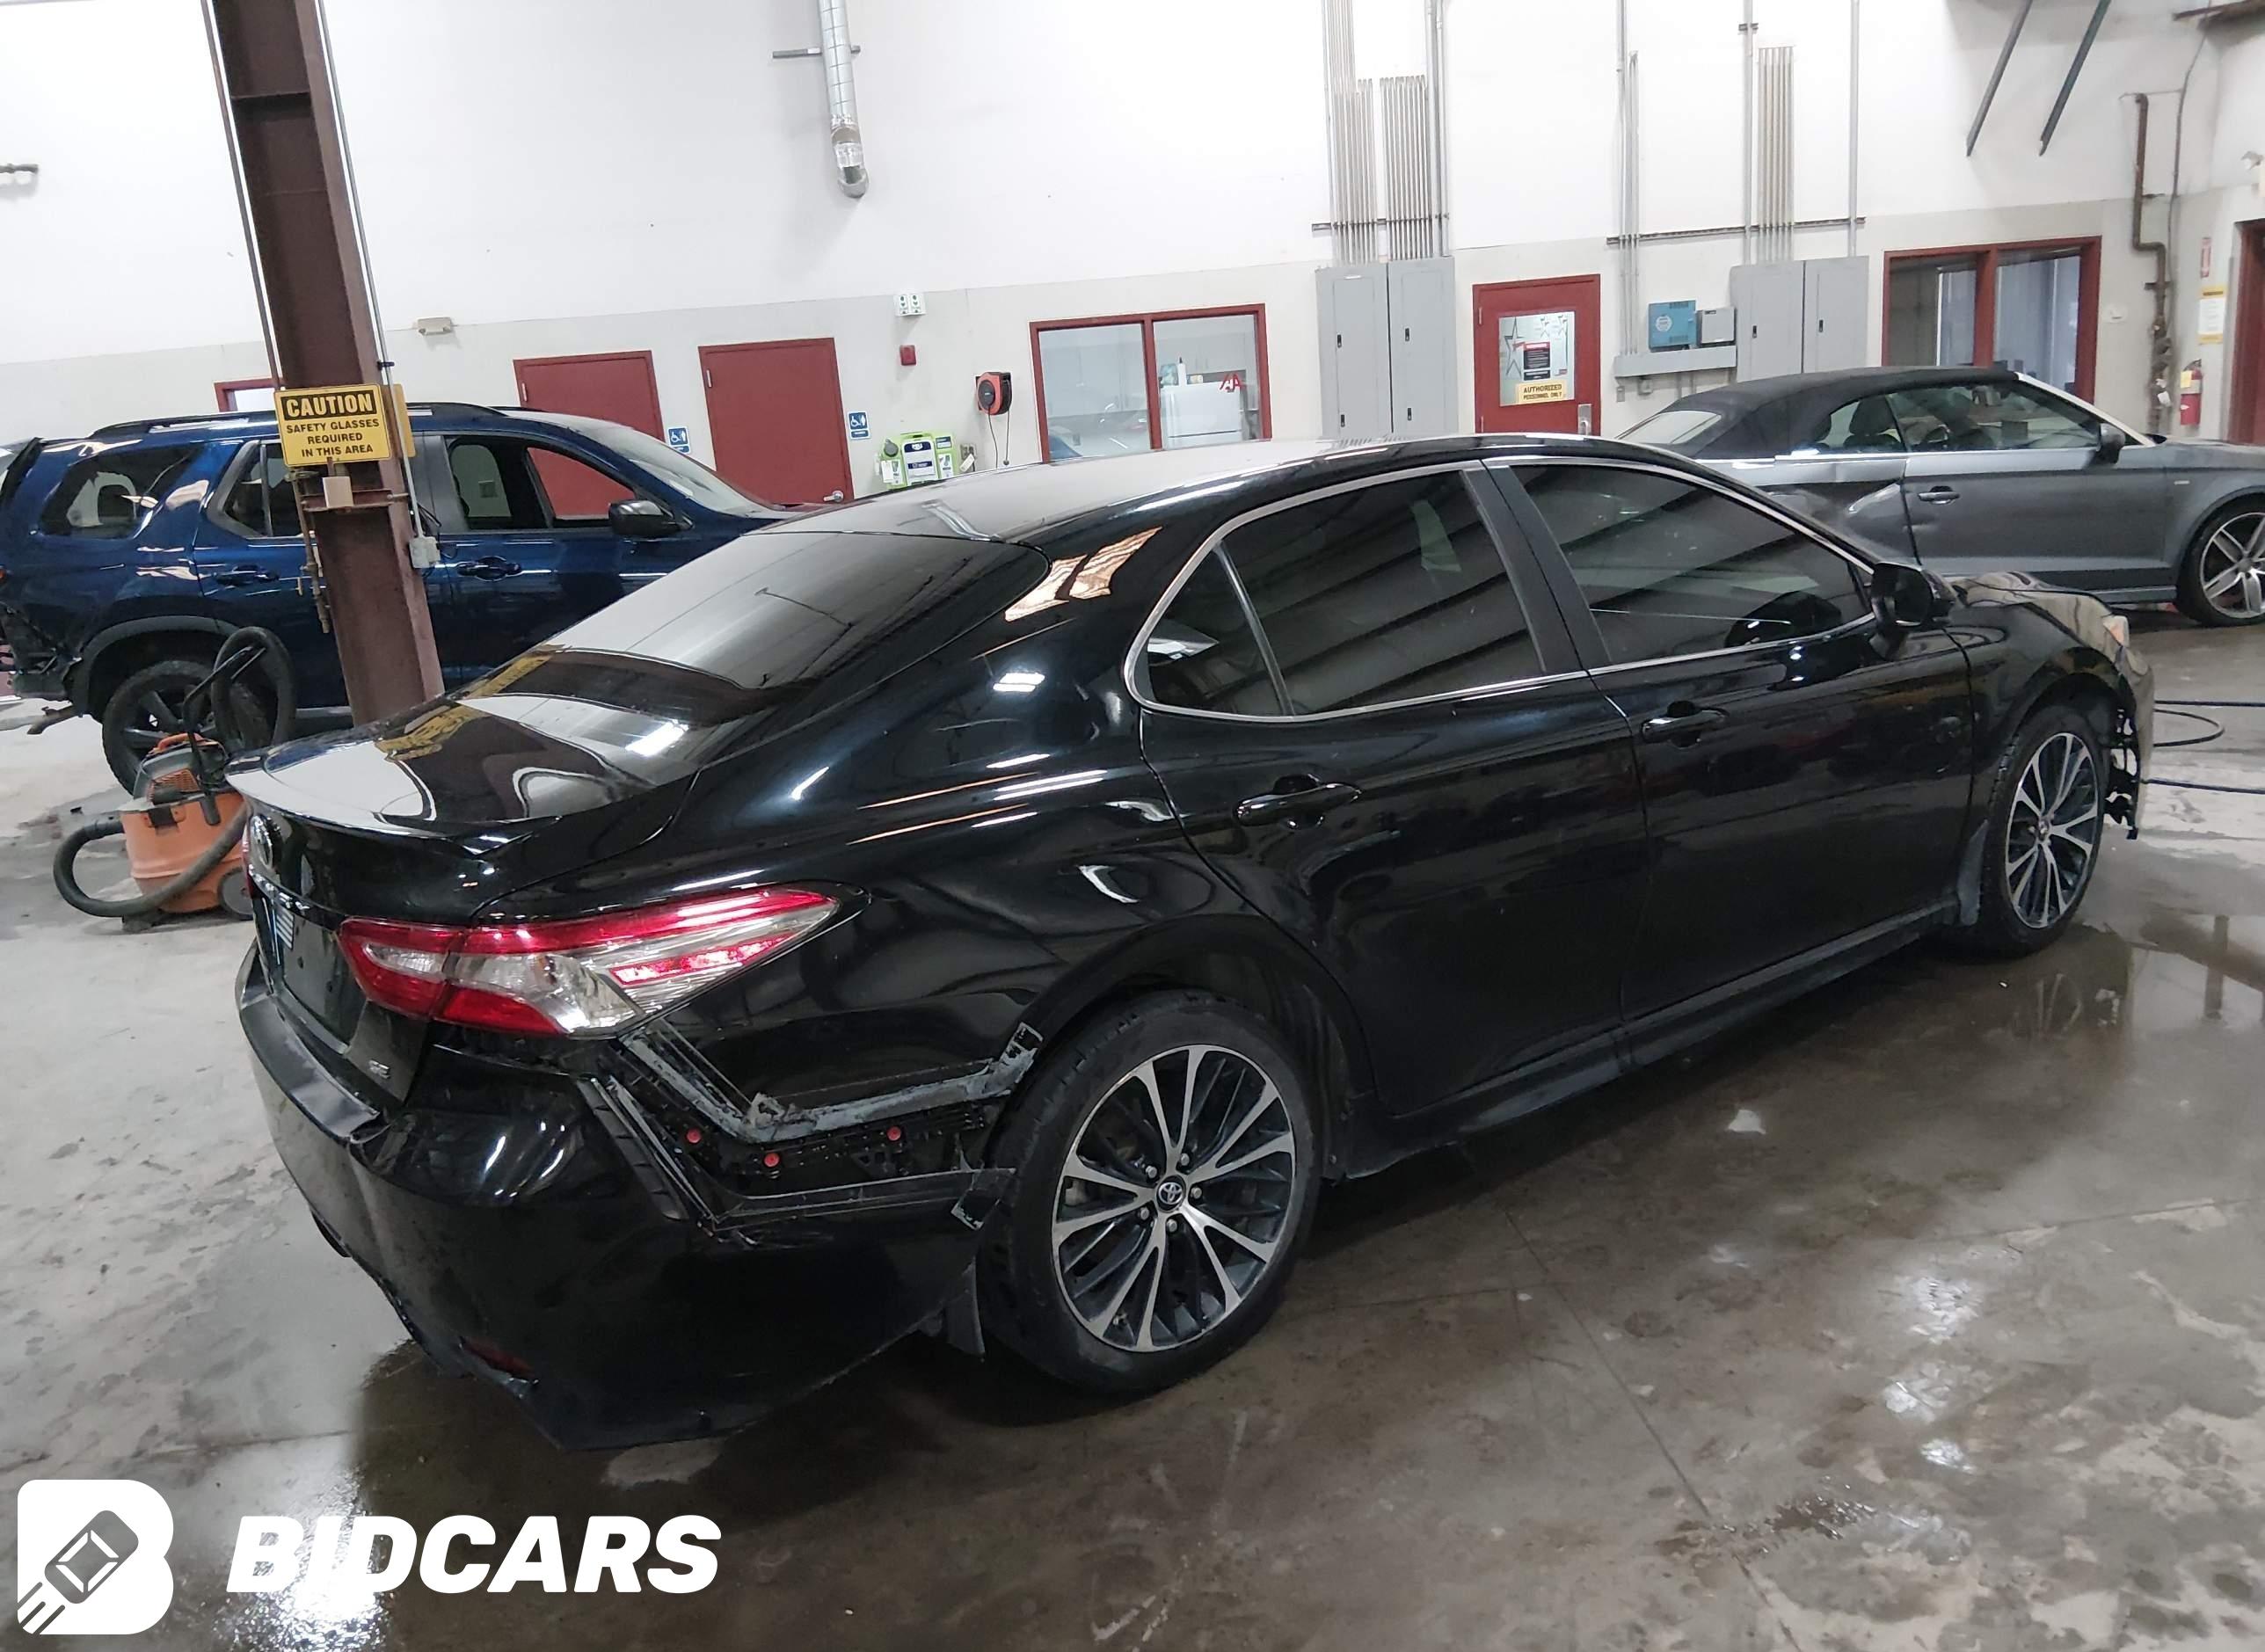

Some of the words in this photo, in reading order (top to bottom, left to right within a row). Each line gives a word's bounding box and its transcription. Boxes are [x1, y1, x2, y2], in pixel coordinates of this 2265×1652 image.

[1524, 384, 1562, 393] AUTHORIZED
[287, 393, 373, 418] CAUTION
[287, 423, 326, 433] SAFETY
[331, 418, 380, 430] GLASSES
[308, 433, 363, 444] REQUIRED
[302, 449, 313, 458] IN
[317, 447, 342, 456] THIS
[346, 444, 374, 454] AREA
